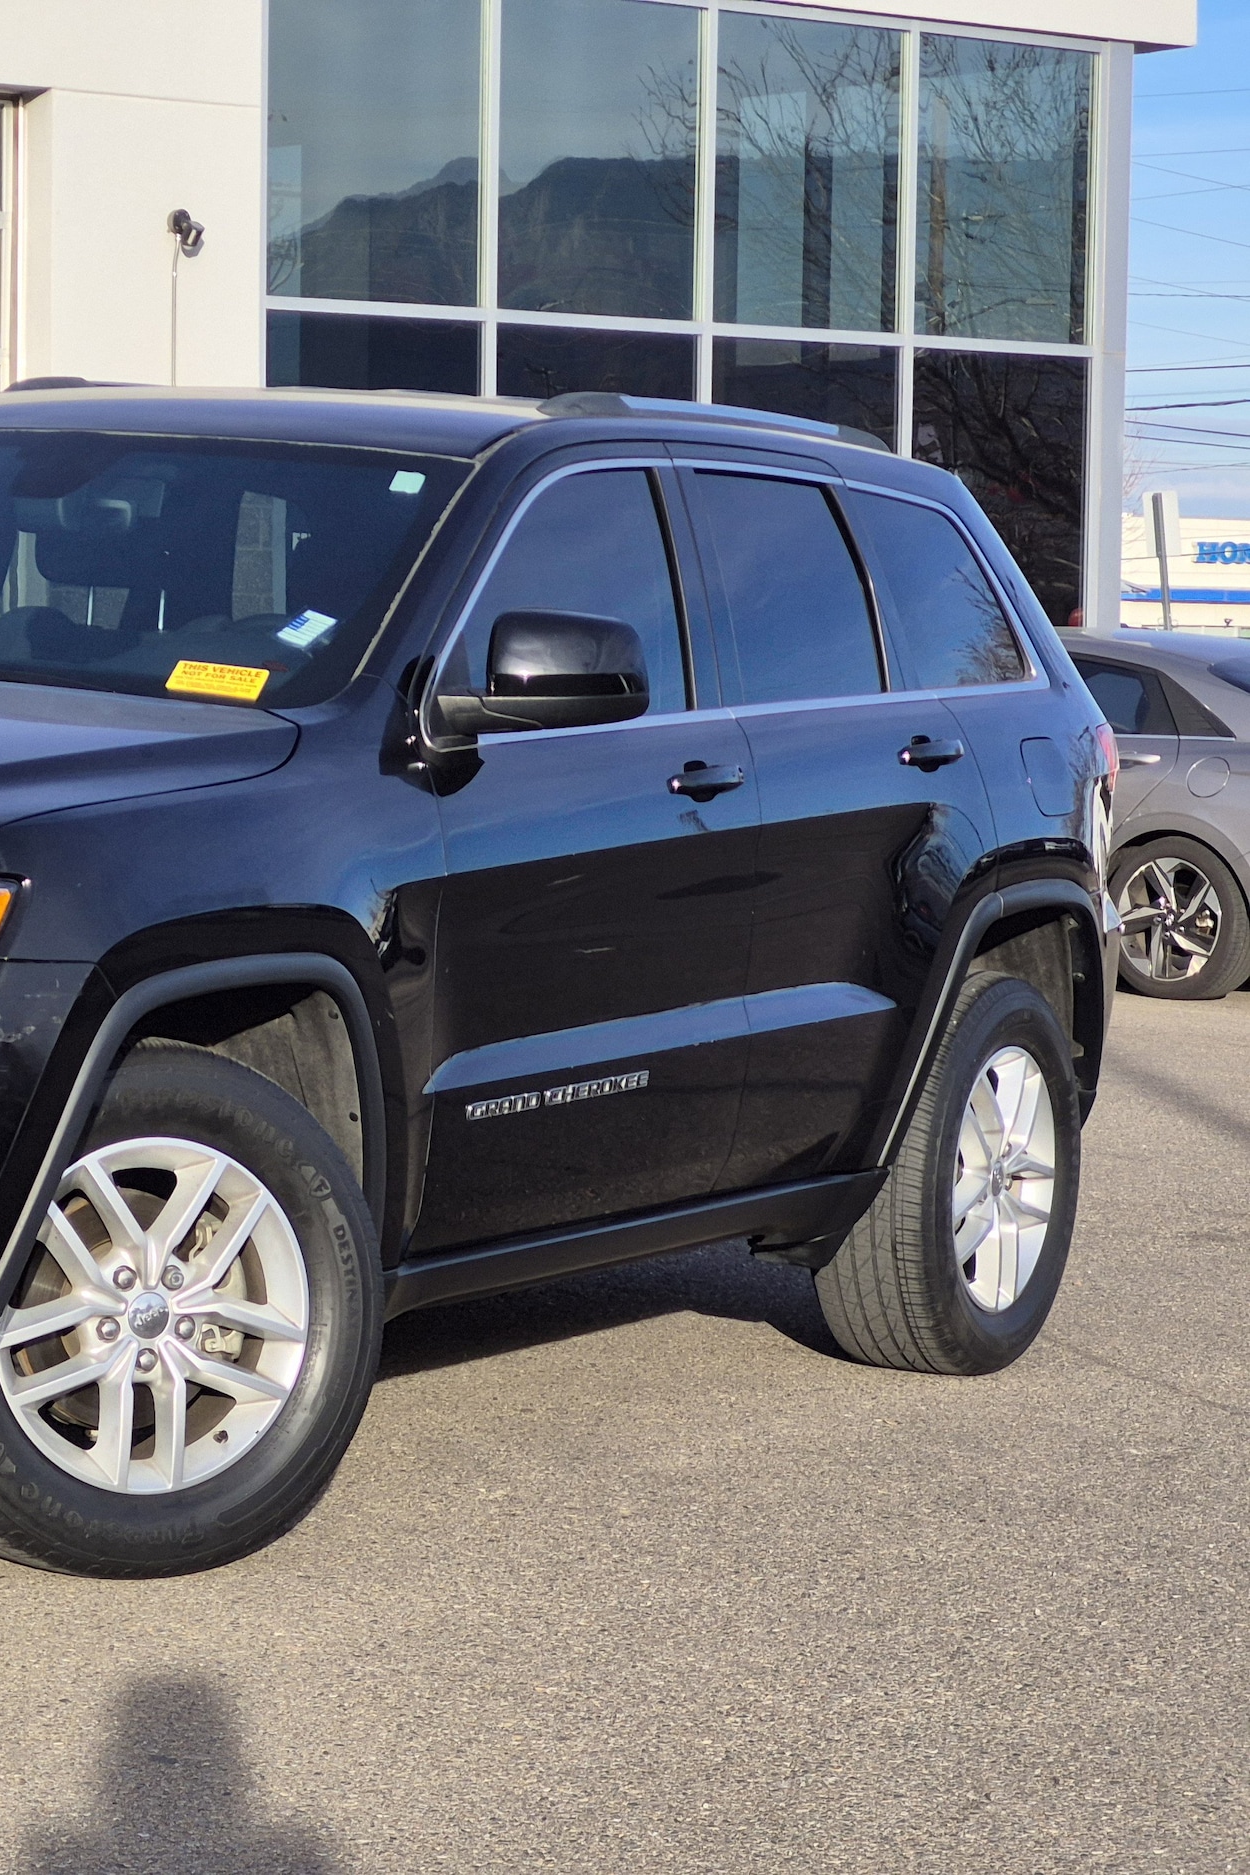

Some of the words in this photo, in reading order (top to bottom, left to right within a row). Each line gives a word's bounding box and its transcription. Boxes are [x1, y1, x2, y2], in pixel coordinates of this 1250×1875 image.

[182, 662, 209, 672] THIS
[212, 666, 263, 678] VEHICLE
[205, 672, 227, 680] FOR
[230, 675, 258, 684] SALE
[464, 1091, 541, 1121] GRAND
[543, 1069, 650, 1107] CHEROKEE
[134, 1305, 169, 1329] Jeep
